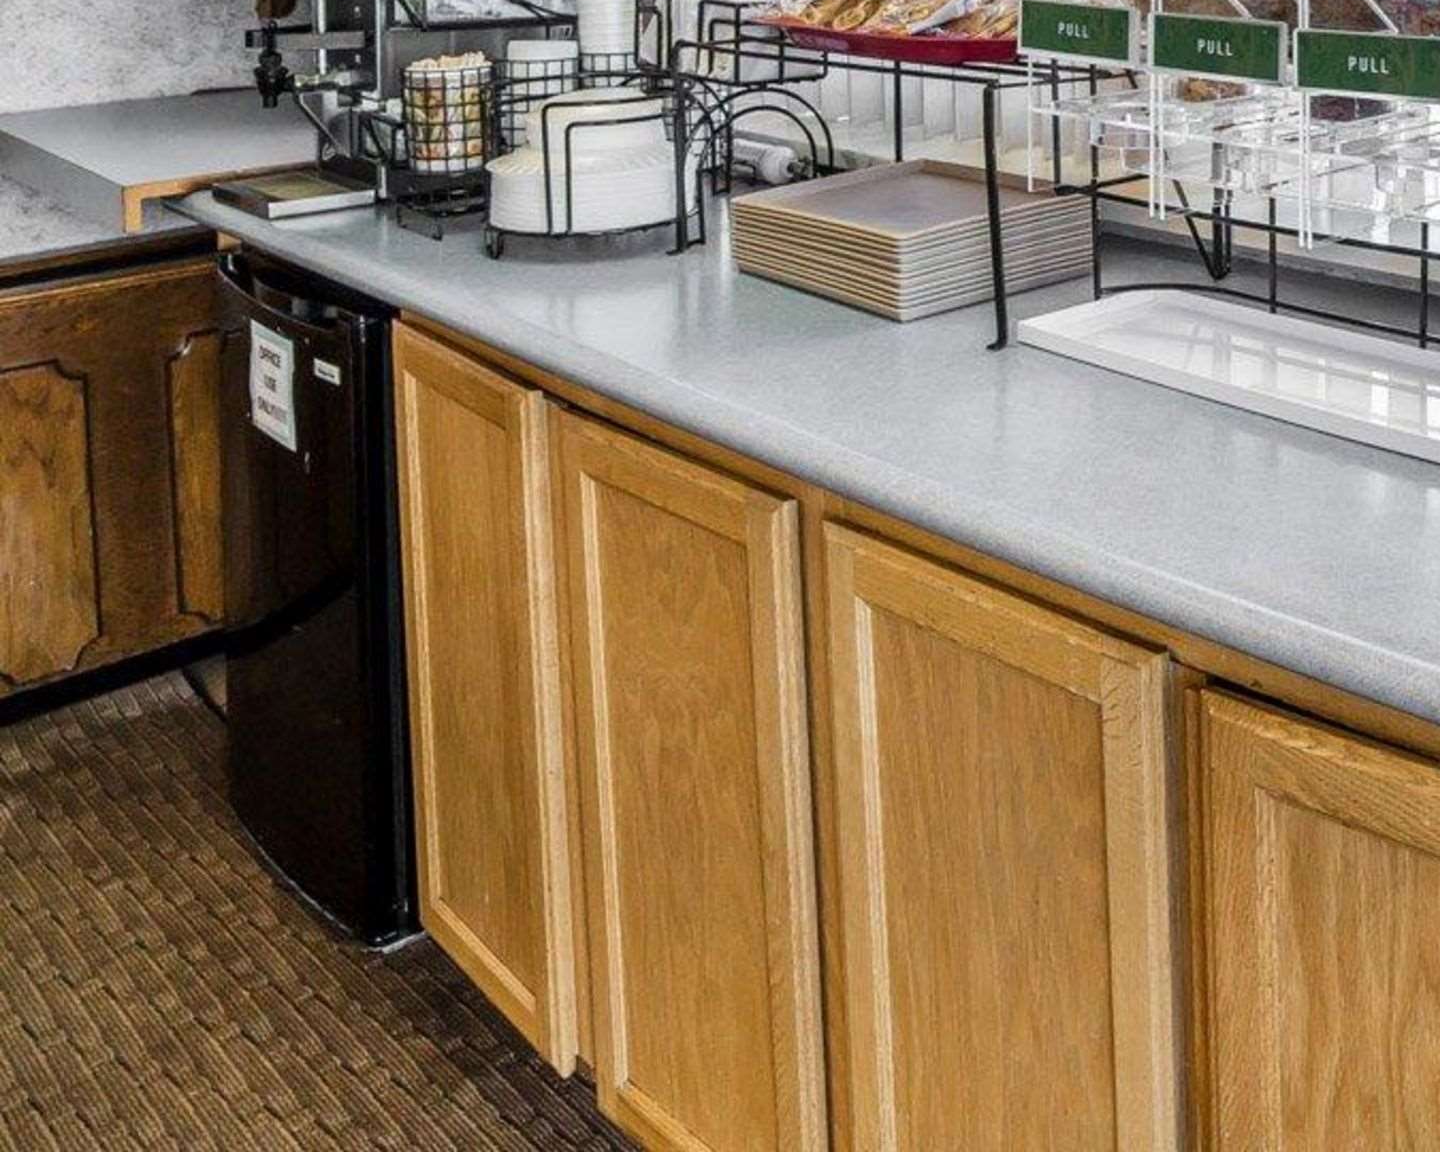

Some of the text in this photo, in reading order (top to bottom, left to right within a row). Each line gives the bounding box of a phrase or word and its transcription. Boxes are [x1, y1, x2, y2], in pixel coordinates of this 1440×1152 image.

[1056, 20, 1090, 40] PULL
[1197, 38, 1234, 57] PULL
[1346, 55, 1390, 75] PULL
